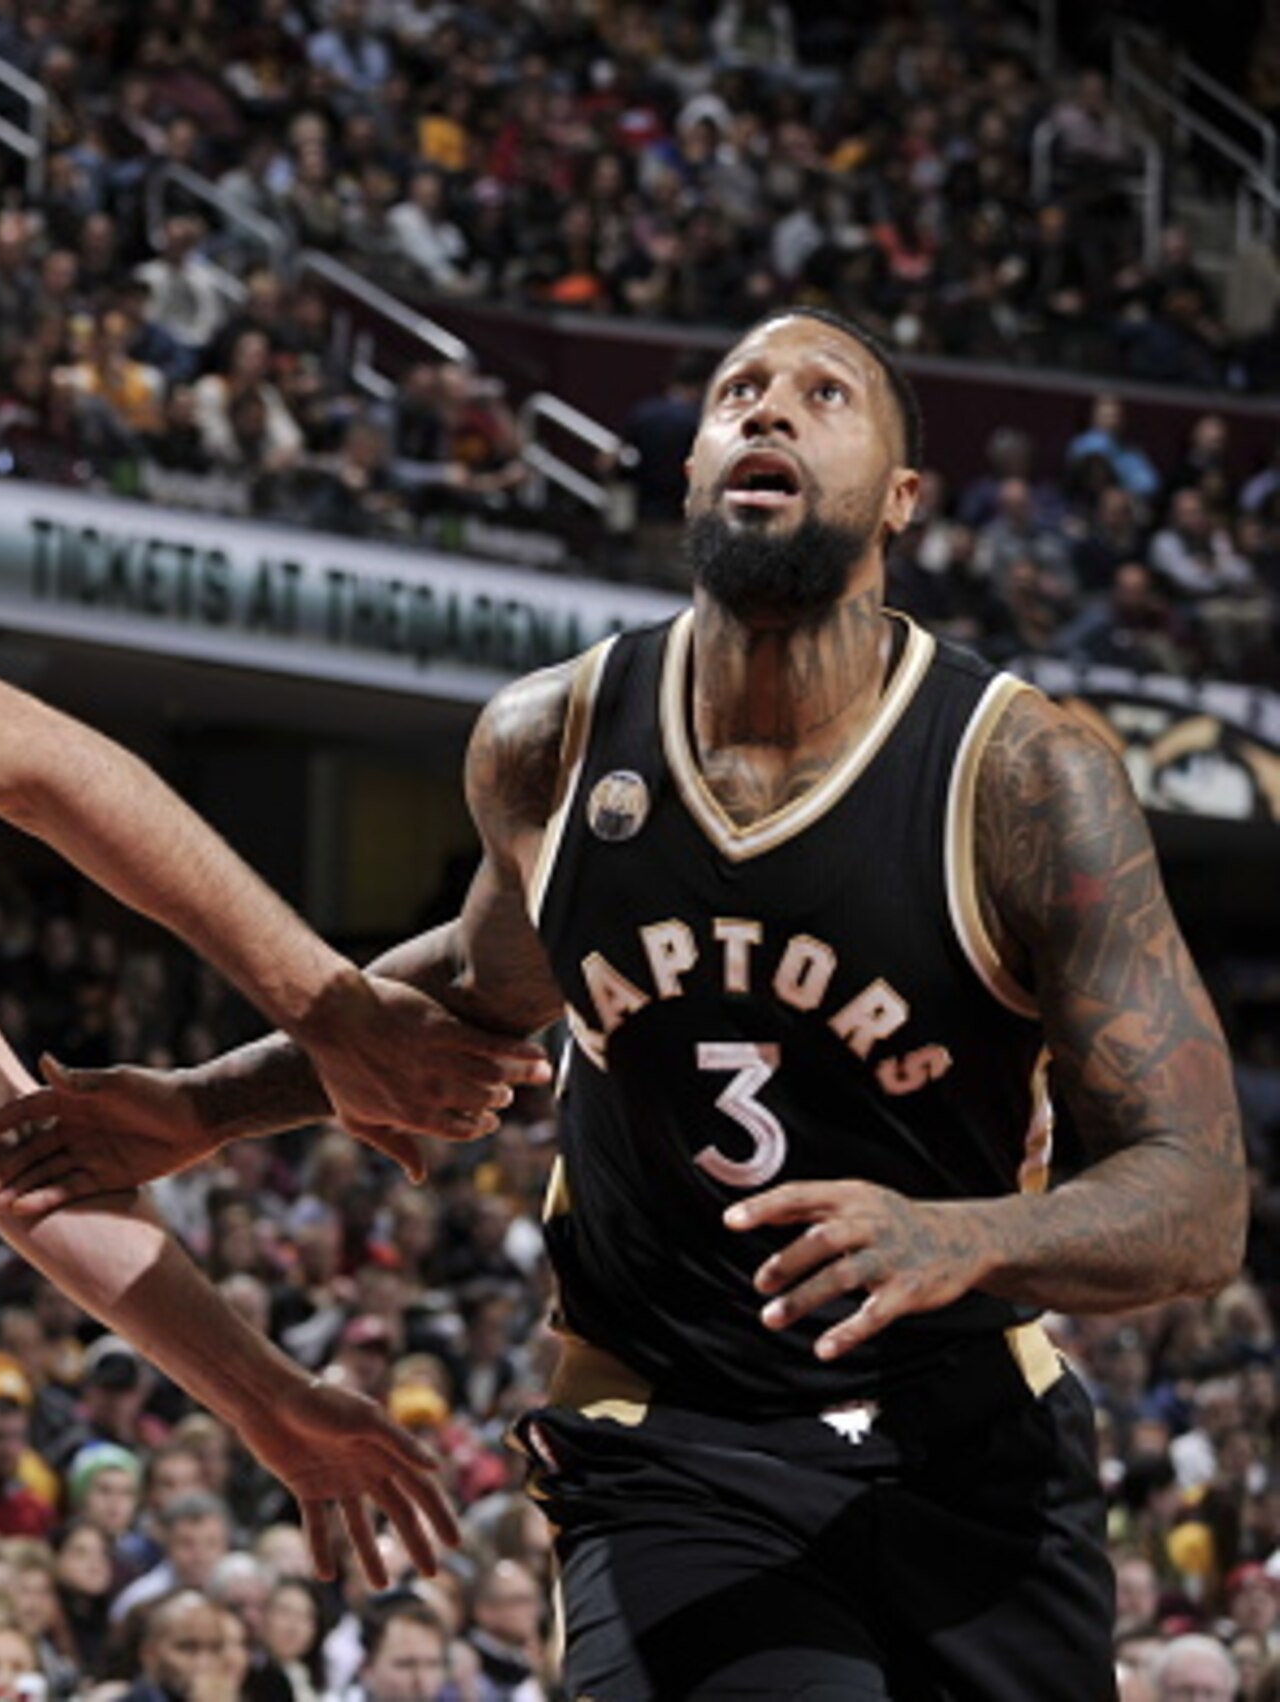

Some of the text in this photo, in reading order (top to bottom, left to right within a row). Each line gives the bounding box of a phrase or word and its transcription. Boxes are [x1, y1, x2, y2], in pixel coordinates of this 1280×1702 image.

[31, 518, 231, 630] TICKETS
[248, 557, 302, 643] AT
[693, 1041, 788, 1188] 3
